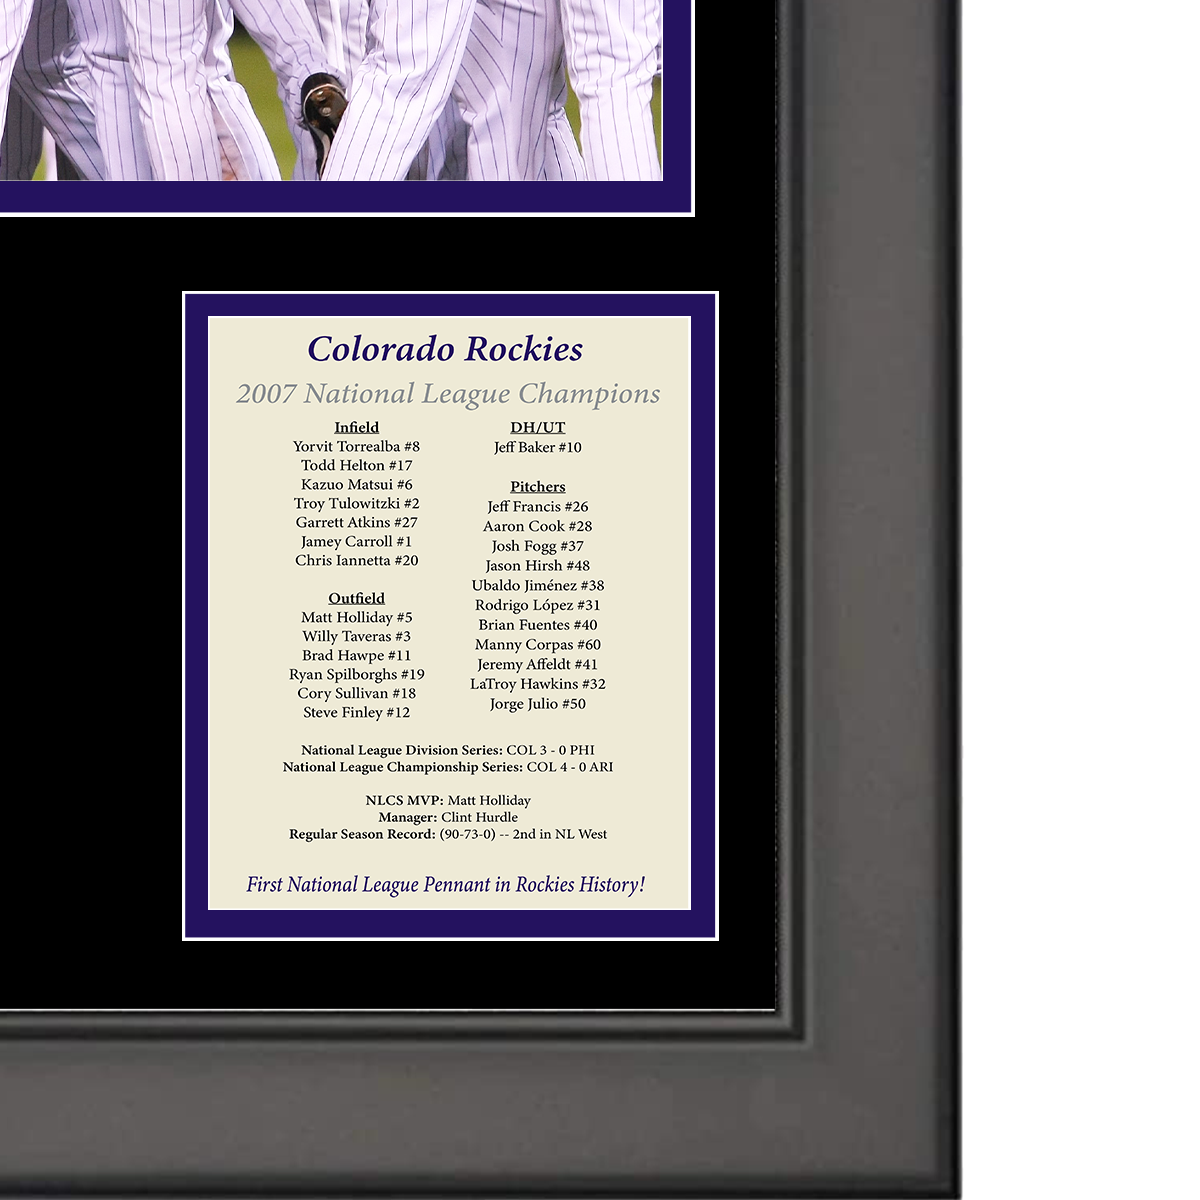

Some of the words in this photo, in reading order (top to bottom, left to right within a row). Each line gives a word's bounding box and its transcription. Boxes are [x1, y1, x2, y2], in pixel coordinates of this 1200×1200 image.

[307, 333, 455, 362] Colorado
[463, 333, 584, 362] Rockies
[235, 383, 298, 404] 2007
[302, 381, 415, 404] National
[421, 382, 511, 411] League
[519, 381, 661, 411] Champions
[333, 420, 380, 435] Infield
[509, 421, 567, 435] DH/UT
[292, 440, 334, 453] Yorvit
[336, 439, 401, 453] Torrealba
[403, 440, 421, 453] #8
[493, 440, 517, 456] Jeff
[518, 440, 556, 453] Baker
[558, 441, 582, 454] #10
[300, 458, 336, 472] Todd
[339, 458, 385, 472] Helton
[388, 459, 413, 472] #17
[301, 478, 344, 491] Kazuo
[347, 478, 394, 491] Matsui
[396, 478, 413, 491] #6
[509, 479, 567, 495] Pitchers
[293, 497, 326, 513] Troy
[328, 496, 401, 510] Tulowitzki
[403, 497, 420, 510] #2
[487, 499, 511, 515] Jeff
[512, 500, 562, 513] Francis
[564, 500, 589, 513] #26
[295, 515, 345, 529] Garrett
[346, 515, 391, 529] Atkins
[393, 516, 418, 529] #27
[482, 520, 525, 533] Aaron
[528, 519, 566, 533] Cook
[568, 520, 593, 533] #28
[300, 535, 343, 551] Jamey
[344, 534, 393, 548] Carroll
[396, 535, 412, 548] #1
[491, 539, 521, 555] Josh
[524, 539, 558, 556] Fogg
[560, 540, 585, 552] #37
[295, 553, 333, 567] Chris
[335, 554, 391, 567] Iannetta
[394, 554, 419, 567] #20
[485, 559, 522, 574] Jason
[525, 558, 563, 572] Hirsh
[566, 559, 591, 572] #48
[471, 578, 521, 592] Ubaldo
[523, 578, 578, 594] Jiménez
[580, 579, 605, 592] #38
[327, 591, 386, 606] Outfield
[474, 598, 529, 615] Rodrigo
[532, 598, 575, 615] López
[576, 599, 601, 611] #31
[301, 611, 333, 624] Matt
[336, 610, 394, 627] Holliday
[396, 611, 413, 624] #5
[478, 618, 515, 631] Brian
[518, 618, 571, 631] Fuentes
[573, 618, 598, 631] #40
[301, 629, 339, 646] Willy
[341, 629, 392, 643] Taveras
[394, 630, 412, 643] #3
[474, 638, 523, 654] Manny
[525, 638, 574, 655] Corpas
[576, 638, 602, 651] #60
[302, 648, 334, 662] Brad
[337, 649, 385, 665] Hawpe
[387, 649, 411, 662] #11
[477, 658, 524, 674] Jeremy
[525, 657, 572, 671] Affeldt
[574, 658, 598, 671] #41
[289, 668, 323, 684] Ryan
[326, 667, 398, 685] Spilborghs
[400, 668, 425, 681] #19
[469, 677, 518, 694] LaTroy
[520, 677, 579, 690] Hawkins
[581, 678, 607, 690] #32
[297, 686, 333, 703] Cory
[334, 686, 389, 700] Sullivan
[392, 687, 417, 700] #18
[489, 697, 525, 714] Jorge
[527, 696, 559, 712] Julio
[561, 697, 587, 710] #50
[303, 705, 339, 719] Steve
[341, 705, 384, 722] Finley
[386, 706, 411, 719] #12
[300, 743, 355, 756] National
[357, 744, 403, 759] League
[405, 744, 459, 756] Division
[461, 744, 503, 756] Series:
[506, 744, 538, 756] COL
[539, 744, 548, 756] 3
[558, 744, 567, 756] 0
[569, 744, 595, 756] PHI
[282, 760, 337, 773] National
[339, 761, 384, 776] League
[386, 760, 479, 776] Championship
[481, 761, 523, 773] Series:
[526, 761, 558, 773] COL
[559, 761, 568, 773] 4
[578, 761, 587, 773] 0
[588, 761, 614, 773] ARI
[365, 794, 404, 807] NLCS
[406, 794, 444, 806] MVP:
[447, 794, 477, 806] Matt
[479, 794, 532, 810] Holliday
[378, 811, 438, 827] Manager:
[441, 810, 473, 823] Clint
[475, 810, 519, 823] Hurdle
[288, 827, 338, 843] Regular
[340, 828, 384, 840] Season
[386, 827, 436, 840] Record:
[439, 827, 496, 842] (90-73-0)
[512, 827, 537, 840] 2nd
[539, 828, 552, 840] in
[554, 828, 576, 840] NL
[577, 828, 608, 840] West
[245, 875, 284, 893] First
[286, 874, 359, 893] National
[361, 875, 419, 899] League
[422, 875, 492, 893] Pennant
[494, 875, 511, 893] in
[514, 874, 575, 893] Rockies
[578, 875, 646, 898] History!
